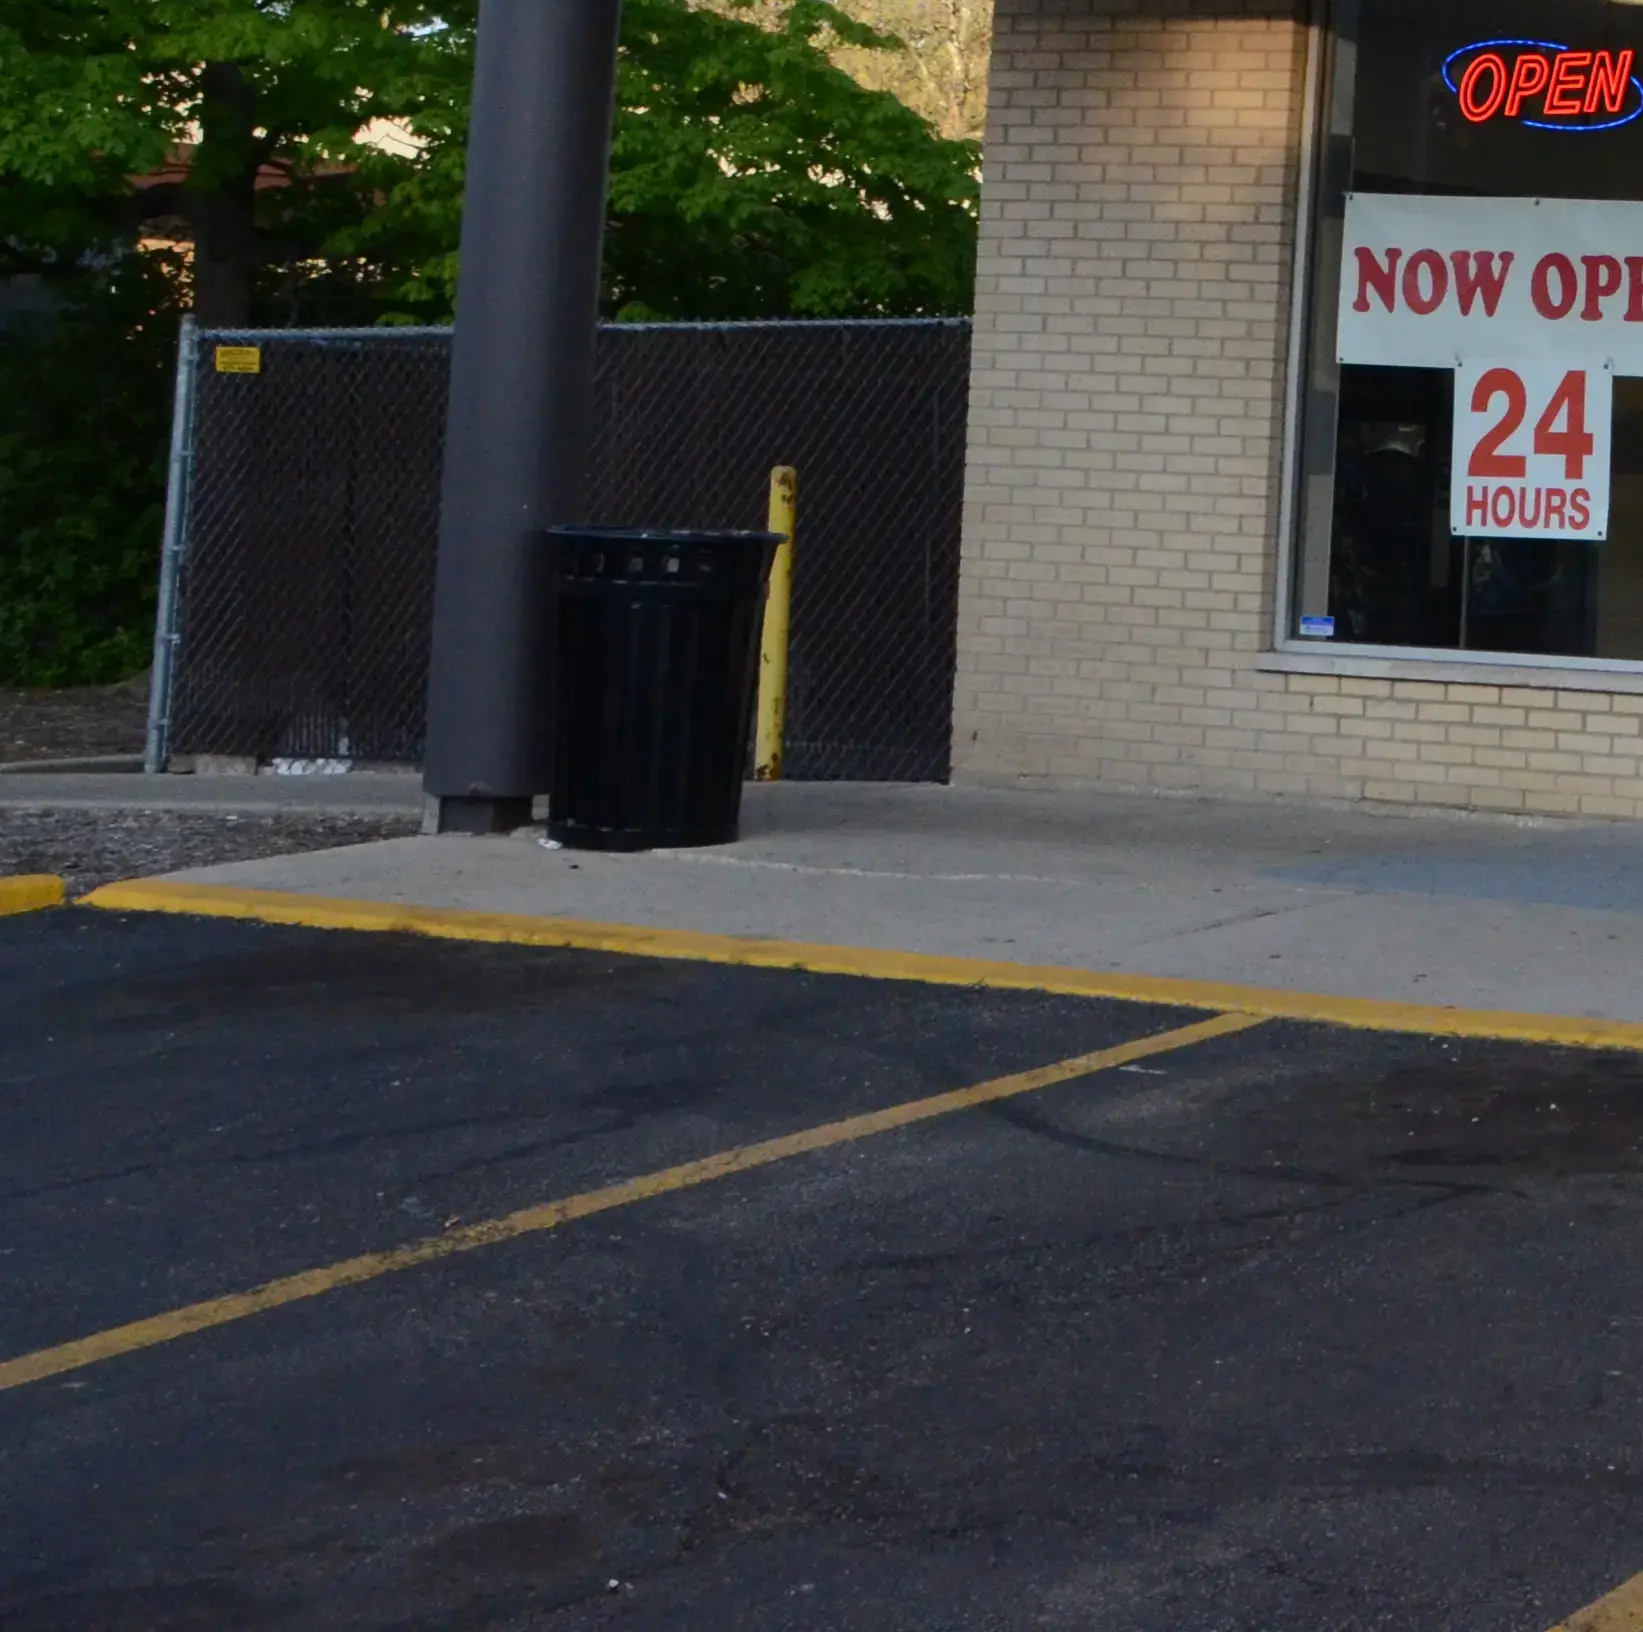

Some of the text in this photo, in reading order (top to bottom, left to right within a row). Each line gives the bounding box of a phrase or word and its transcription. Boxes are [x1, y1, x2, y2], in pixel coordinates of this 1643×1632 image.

[1459, 49, 1633, 123] OPEN
[1352, 247, 1514, 317] NOW
[1467, 368, 1593, 480] 24
[1465, 487, 1590, 530] HOURS
